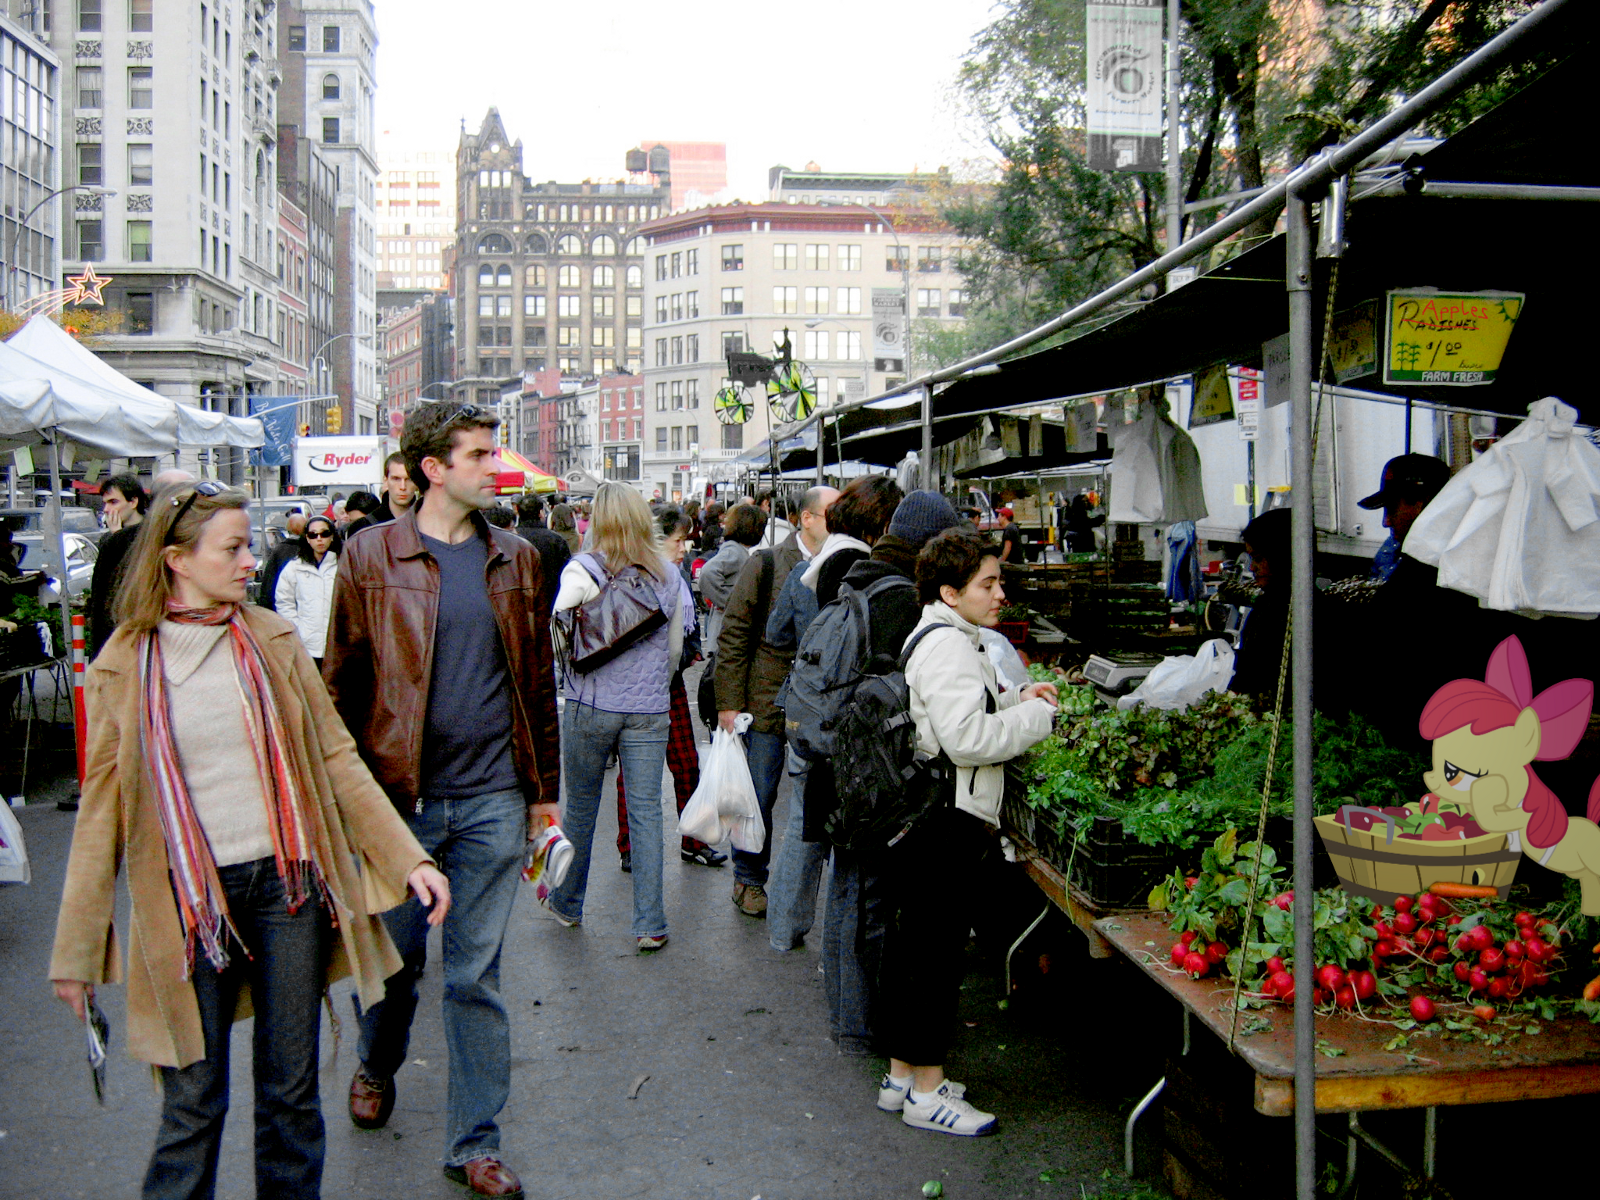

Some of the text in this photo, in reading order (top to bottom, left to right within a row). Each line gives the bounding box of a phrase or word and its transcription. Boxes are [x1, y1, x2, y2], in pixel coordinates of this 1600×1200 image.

[1421, 371, 1484, 382] FARM FRESH
[323, 453, 372, 468] Ryder
